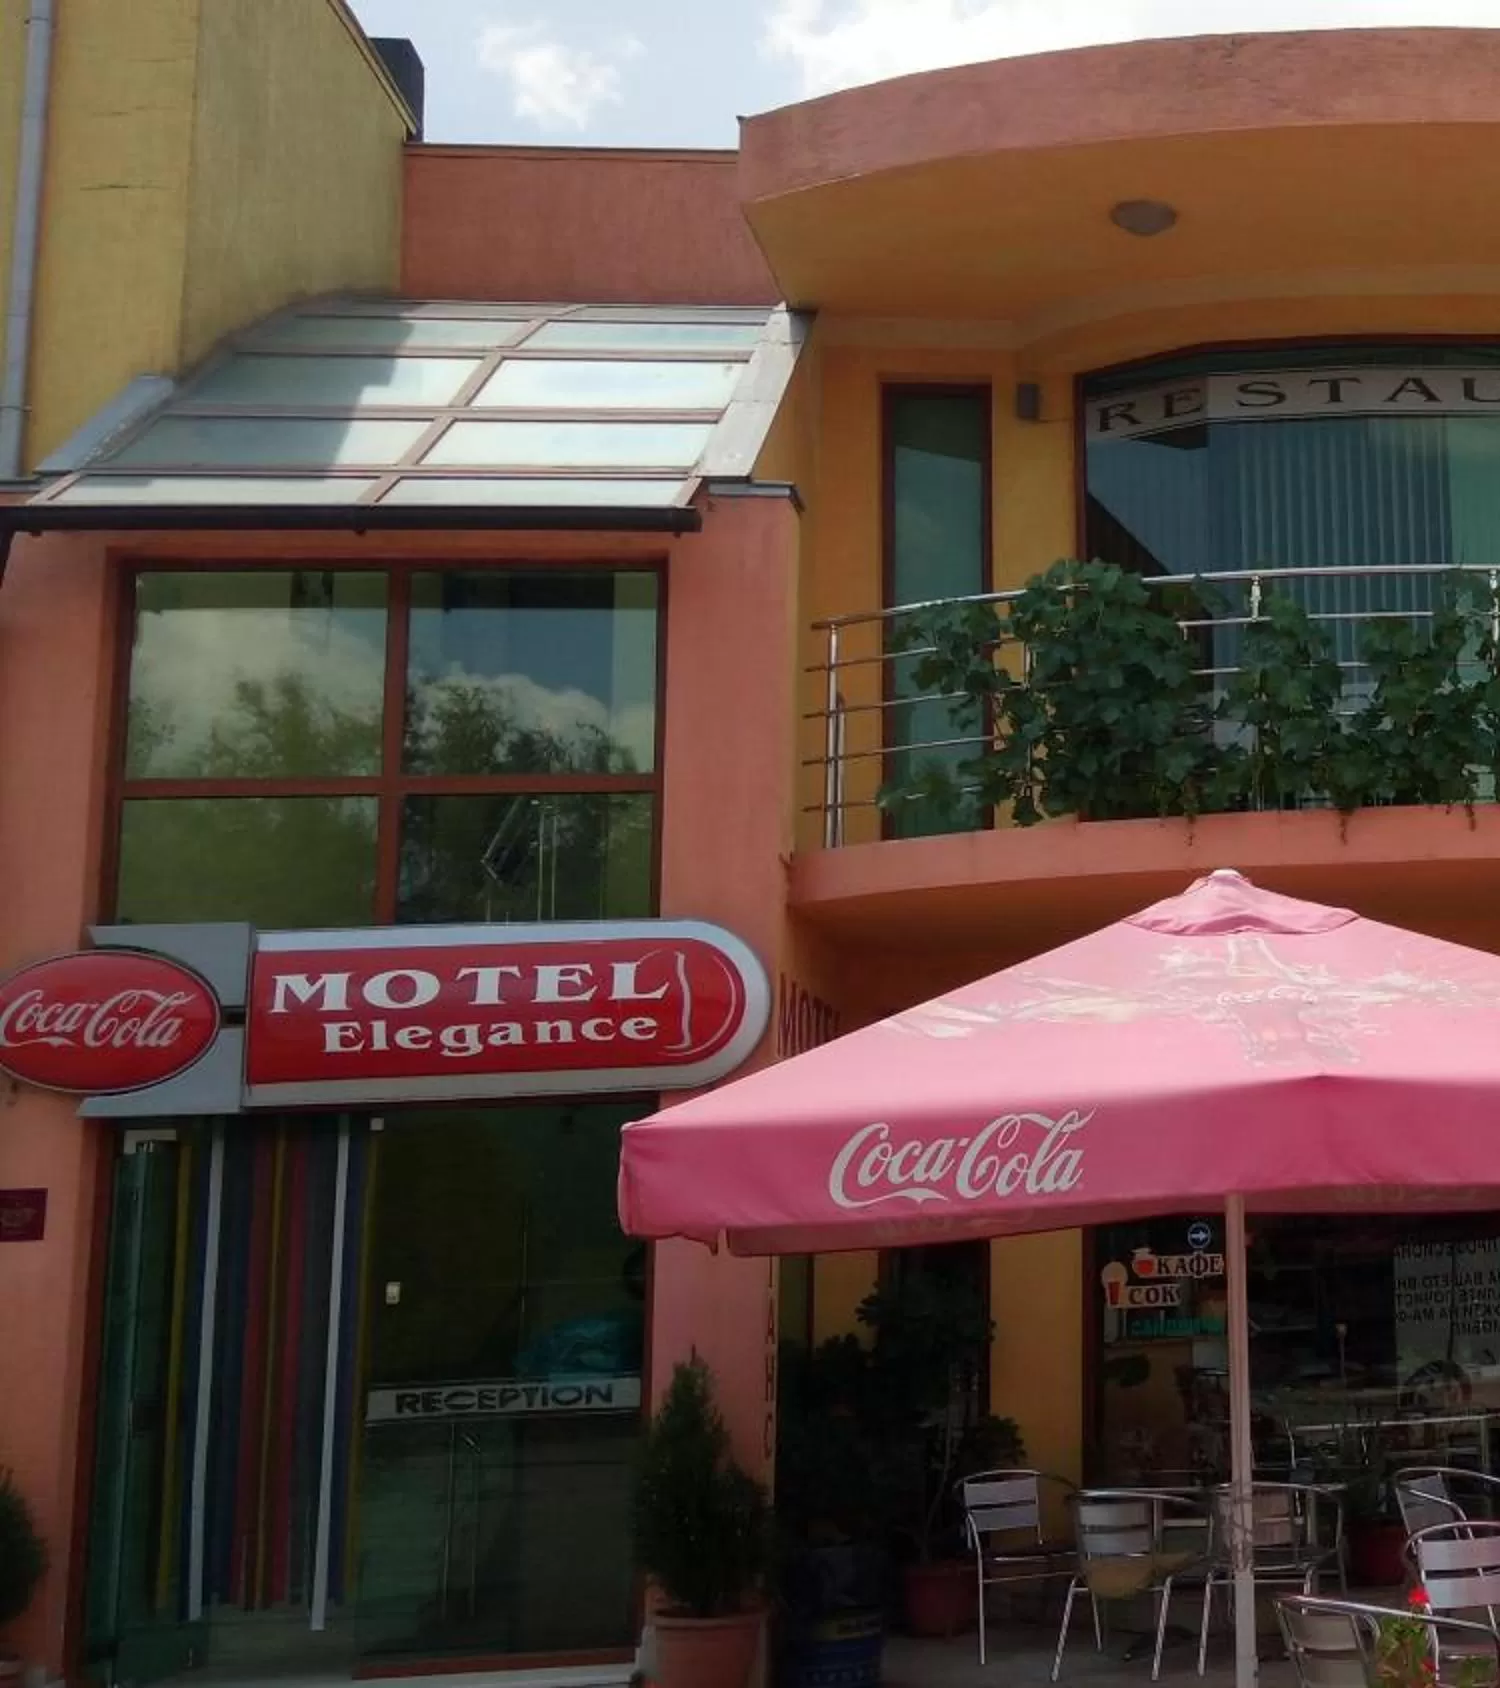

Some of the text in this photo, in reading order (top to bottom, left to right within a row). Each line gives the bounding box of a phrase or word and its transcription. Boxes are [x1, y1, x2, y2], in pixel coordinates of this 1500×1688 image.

[268, 961, 670, 1014] MOTEL
[0, 988, 198, 1048] Coca-Cola
[321, 1015, 659, 1057] Elegance
[829, 1103, 1097, 1210] Coca-Cola
[1157, 1252, 1222, 1277] КАФЕ
[394, 1383, 614, 1415] RECEPTION
